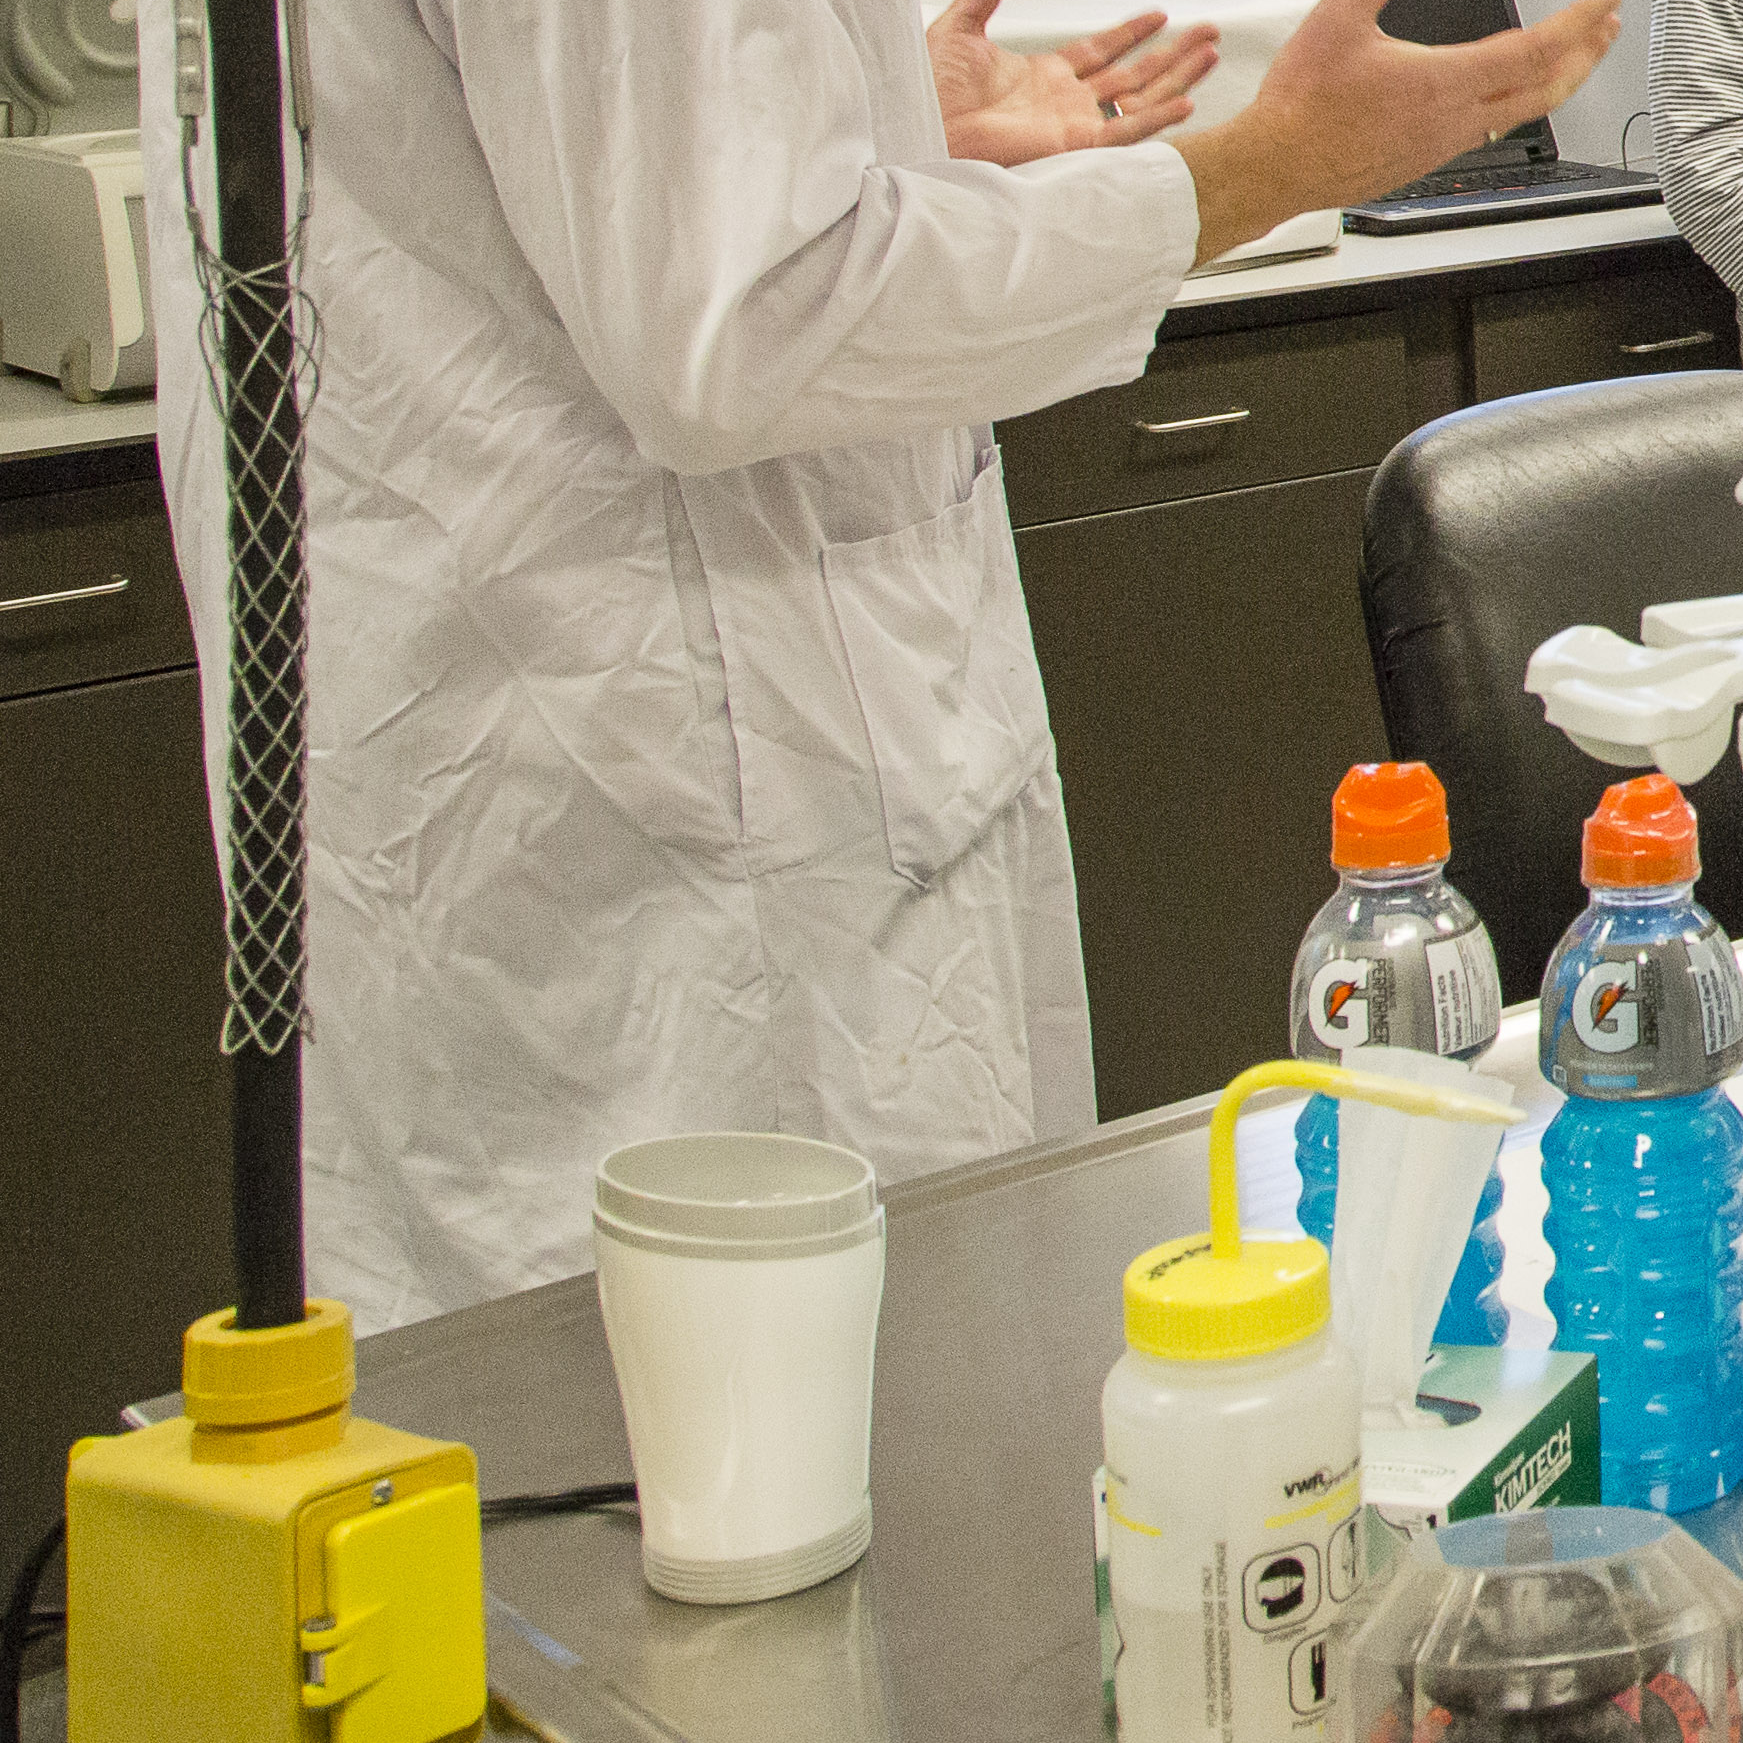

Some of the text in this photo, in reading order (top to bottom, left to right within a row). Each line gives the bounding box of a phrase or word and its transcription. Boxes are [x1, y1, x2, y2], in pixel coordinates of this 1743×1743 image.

[1309, 958, 1369, 1050] G
[1572, 960, 1640, 1053] G
[1284, 1469, 1326, 1500] VWR
[1495, 1420, 1571, 1515] KIMTECH
